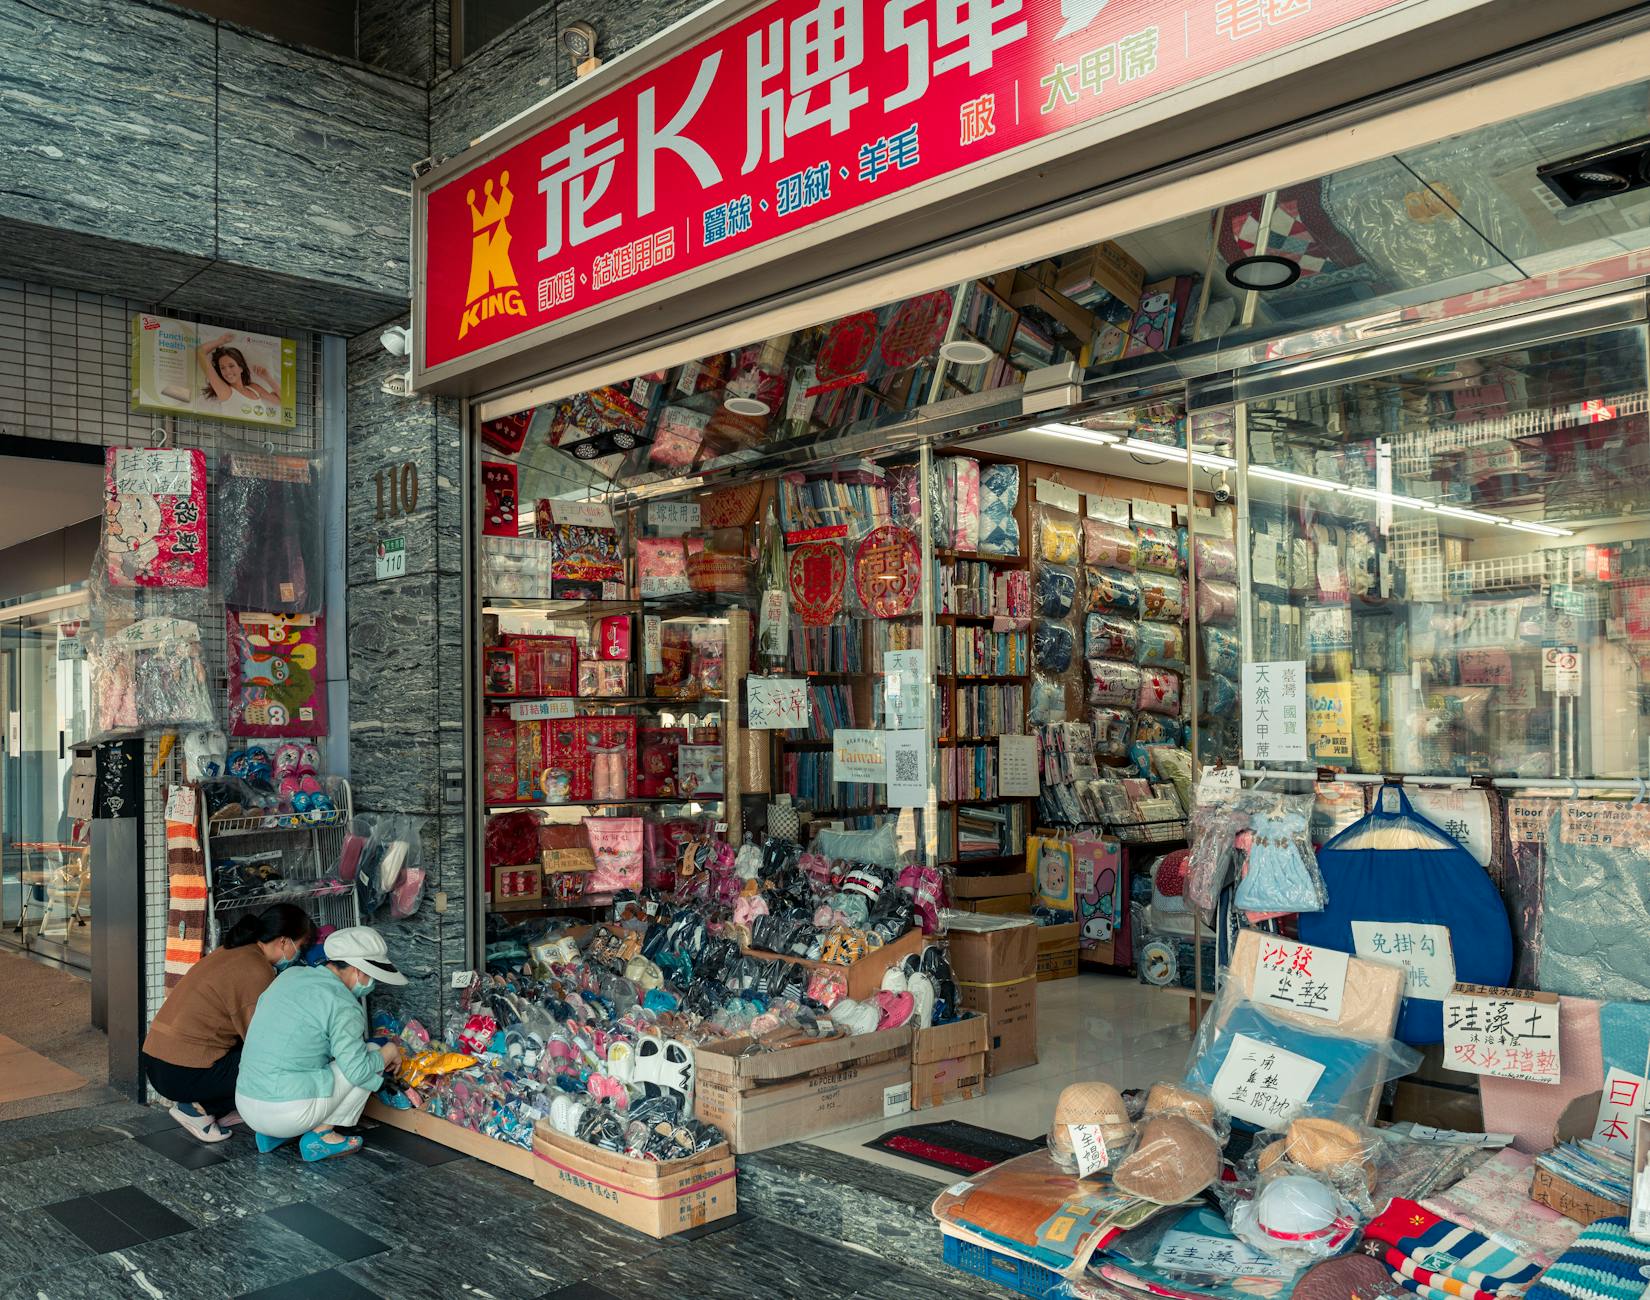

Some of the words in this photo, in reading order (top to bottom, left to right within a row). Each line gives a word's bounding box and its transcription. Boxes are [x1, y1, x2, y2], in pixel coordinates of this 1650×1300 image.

[537, 0, 1110, 262] 老K牌彈
[537, 226, 675, 312] 訂婚、結婚用品
[702, 123, 920, 247] 蠶絲、羽絨、羊毛
[960, 93, 996, 147] 被
[1040, 26, 1160, 115] 大甲蓆
[457, 288, 528, 341] KING
[158, 339, 187, 351] Health
[375, 462, 419, 521] 110
[386, 554, 402, 573] 110
[1281, 668, 1297, 698] 臺灣
[750, 685, 768, 726] 天然
[1255, 665, 1270, 758] 天然大甲蓆
[1283, 704, 1297, 735] 國寶
[838, 747, 885, 765] Taiwan
[1514, 807, 1543, 818] Floor
[1568, 808, 1599, 819] Floor
[1263, 941, 1313, 977] 沙發
[1371, 931, 1436, 957] 免掛勾
[1269, 976, 1329, 1012] 坐墊
[1406, 966, 1431, 988] 帳
[1448, 1000, 1552, 1039] 珪藻土
[1454, 1044, 1560, 1076] 吸水踏墊
[1600, 1079, 1640, 1143] 日本
